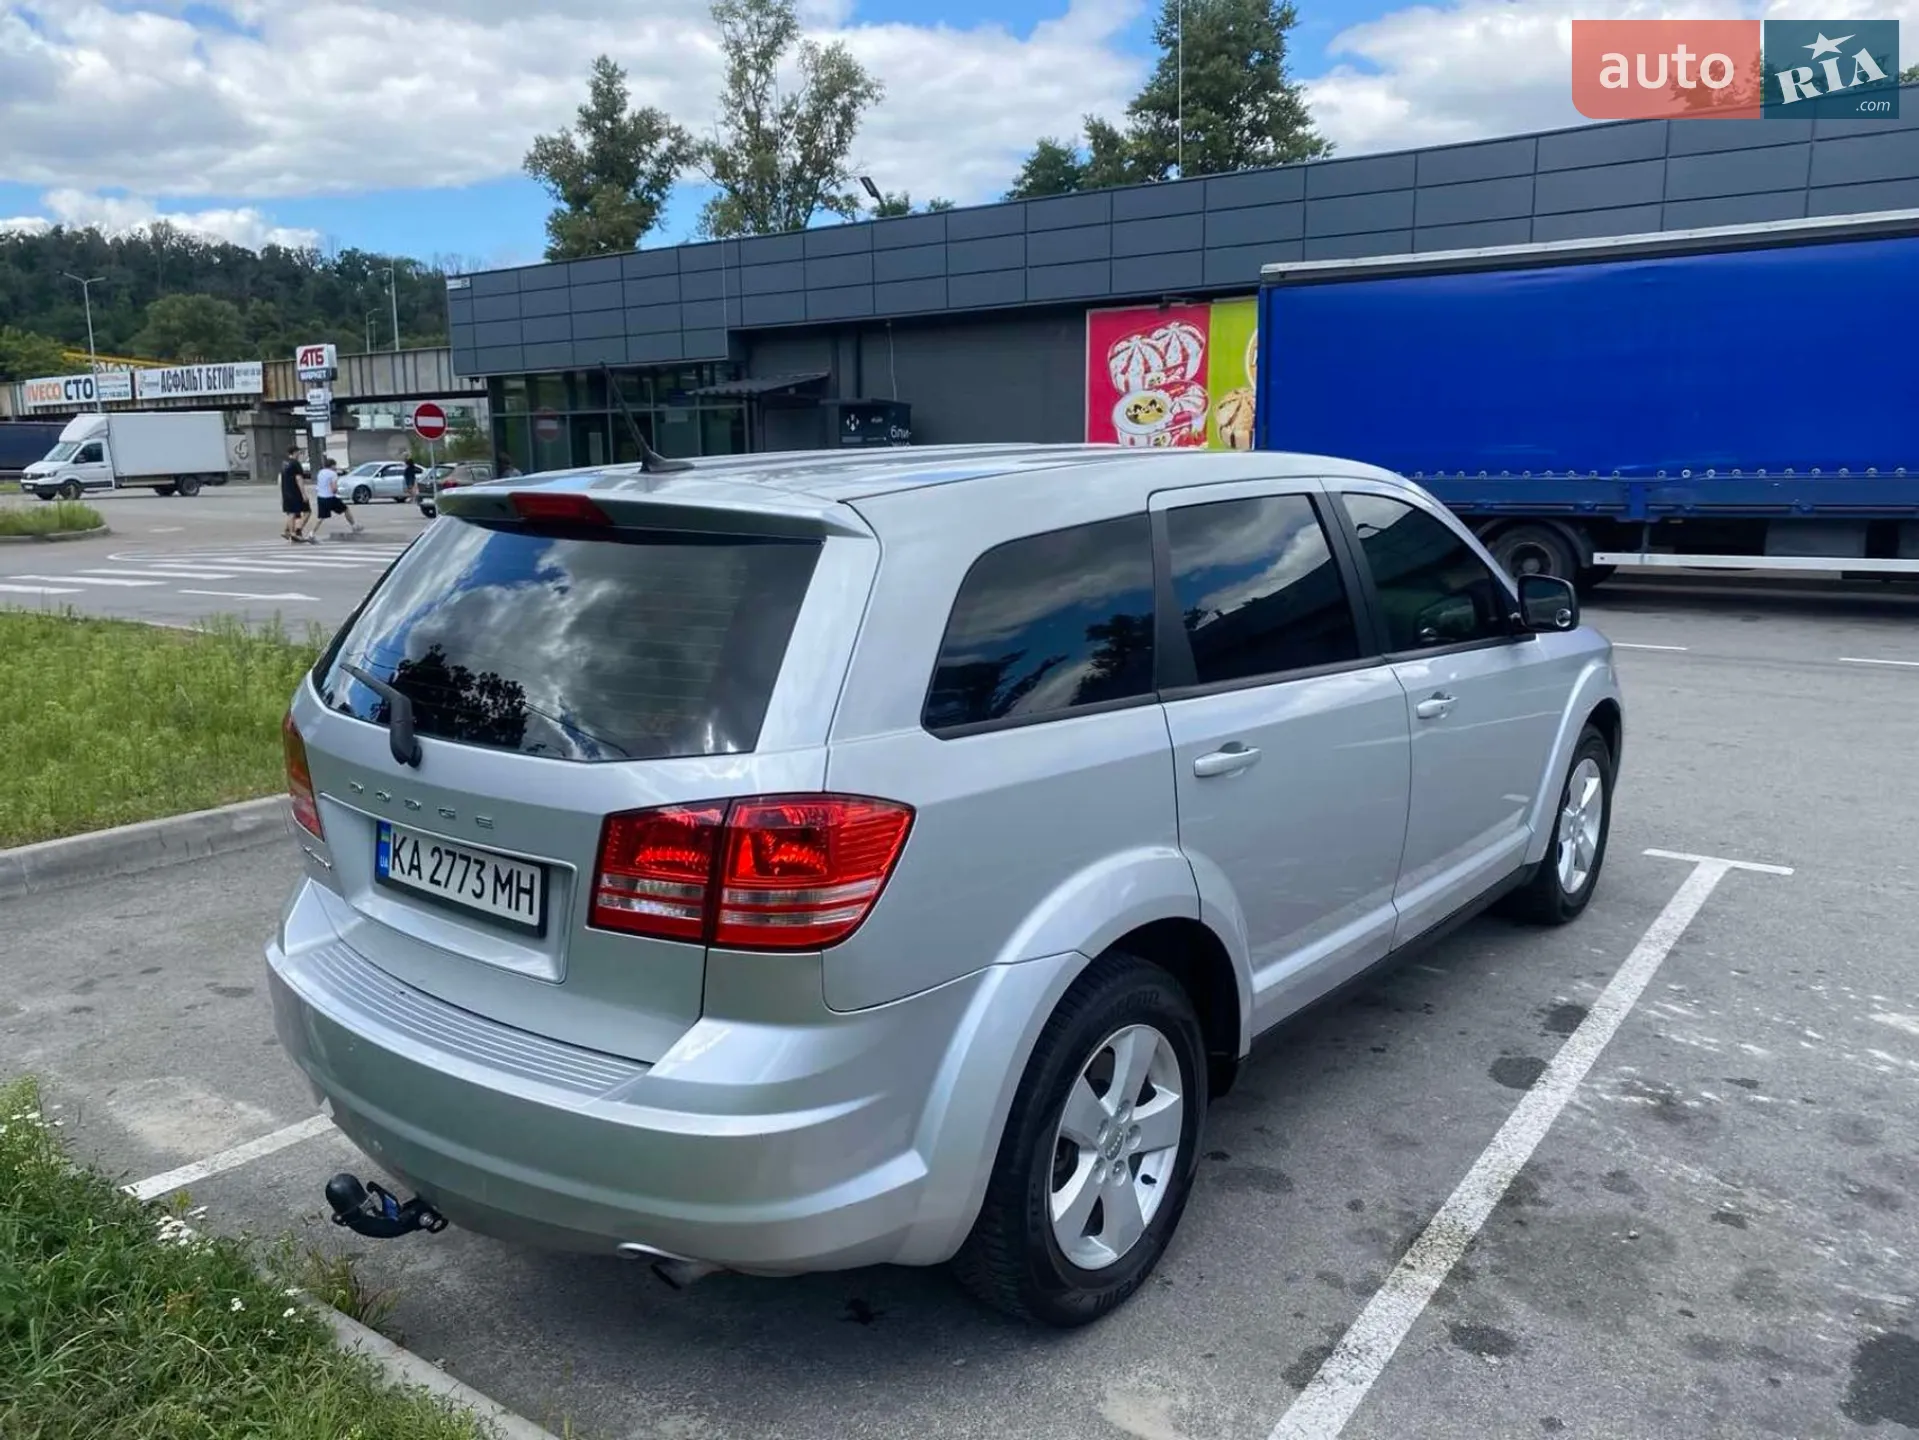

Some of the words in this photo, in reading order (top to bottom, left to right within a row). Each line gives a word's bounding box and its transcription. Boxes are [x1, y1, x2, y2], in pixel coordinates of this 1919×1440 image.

[300, 347, 325, 366] АТБ
[27, 382, 61, 402] IVECO
[160, 368, 203, 393] АСФАЛЬТ
[206, 366, 235, 390] БЕТОН
[350, 781, 494, 830] DODGE
[391, 832, 422, 880] KA
[430, 845, 485, 899] 2773
[492, 864, 535, 916] MH
